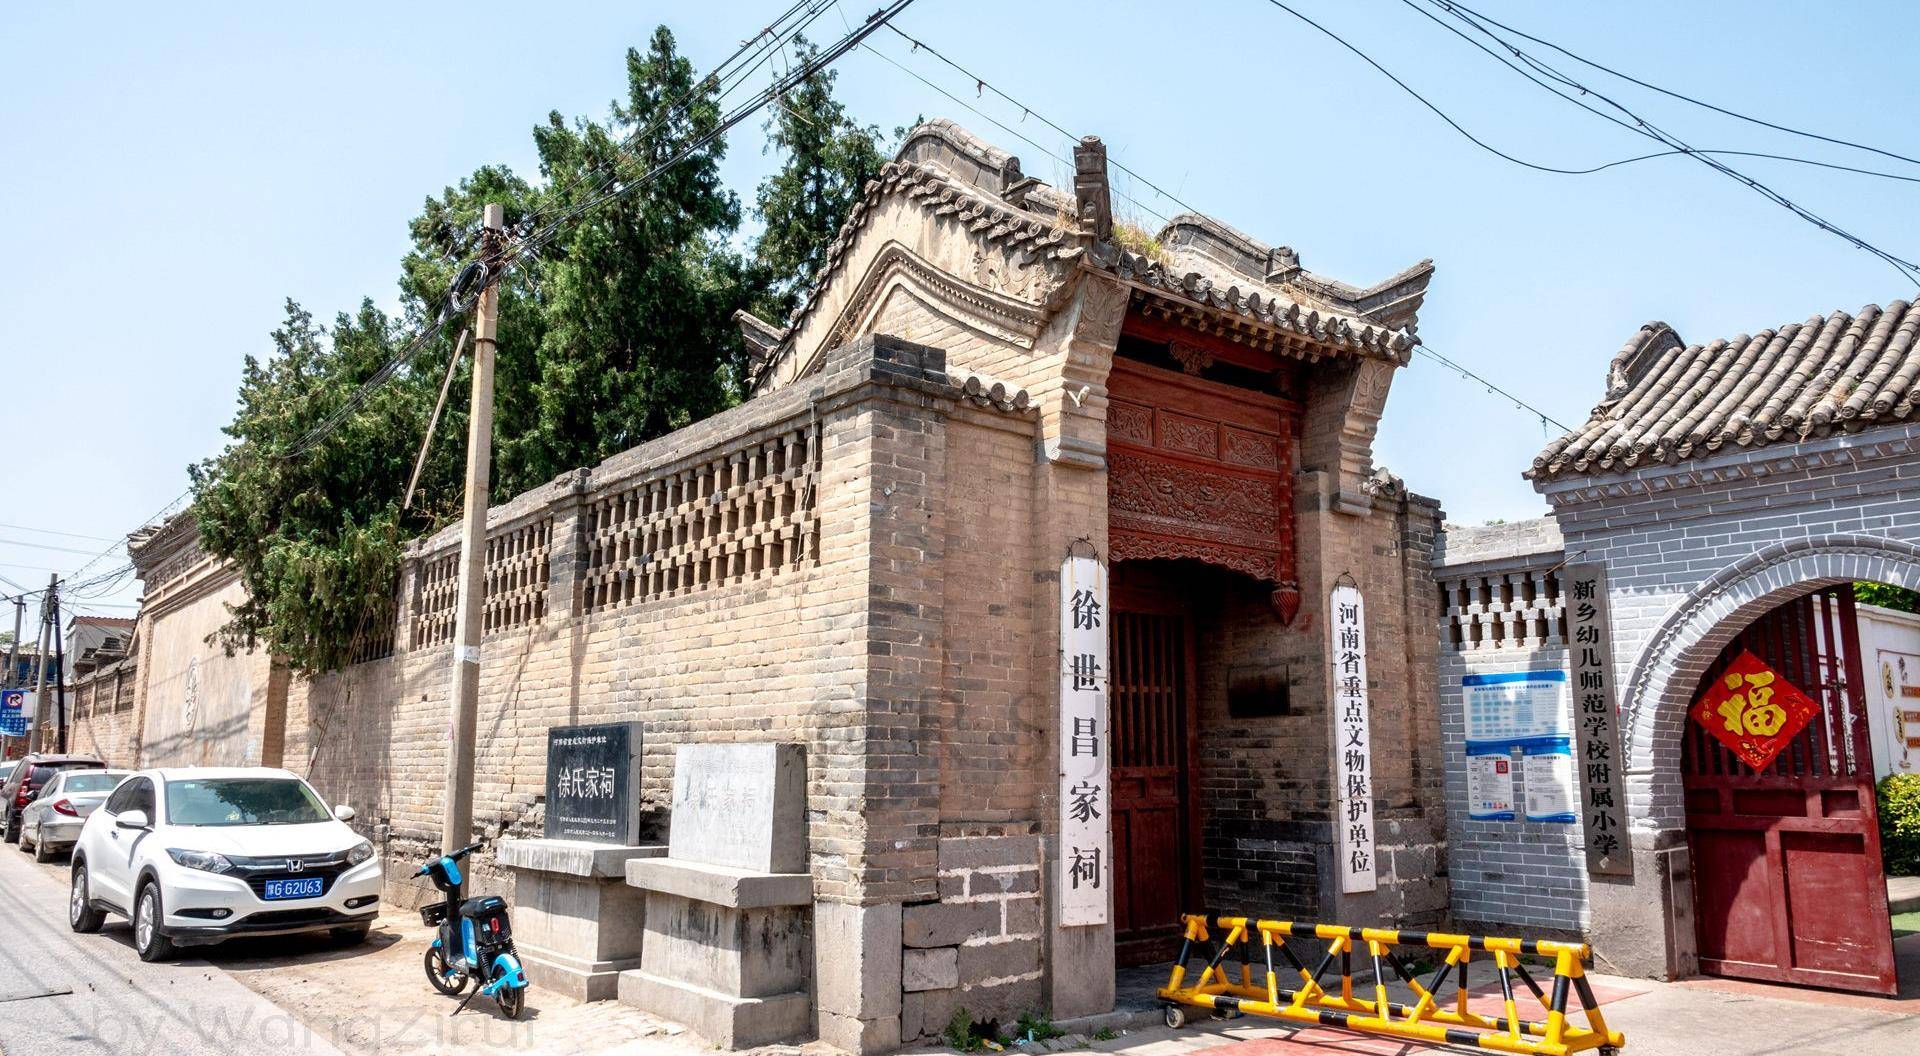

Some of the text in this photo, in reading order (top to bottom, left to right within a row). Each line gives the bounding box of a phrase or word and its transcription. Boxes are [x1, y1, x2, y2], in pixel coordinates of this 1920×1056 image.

[557, 765, 615, 799] 徐氏家祠
[1067, 588, 1102, 891] 徐世昌家祠
[1338, 602, 1371, 875] 河南省重点文物保护单位
[1573, 579, 1618, 857] 新乡幼儿师范学校附属小学
[1716, 670, 1788, 737] 福
